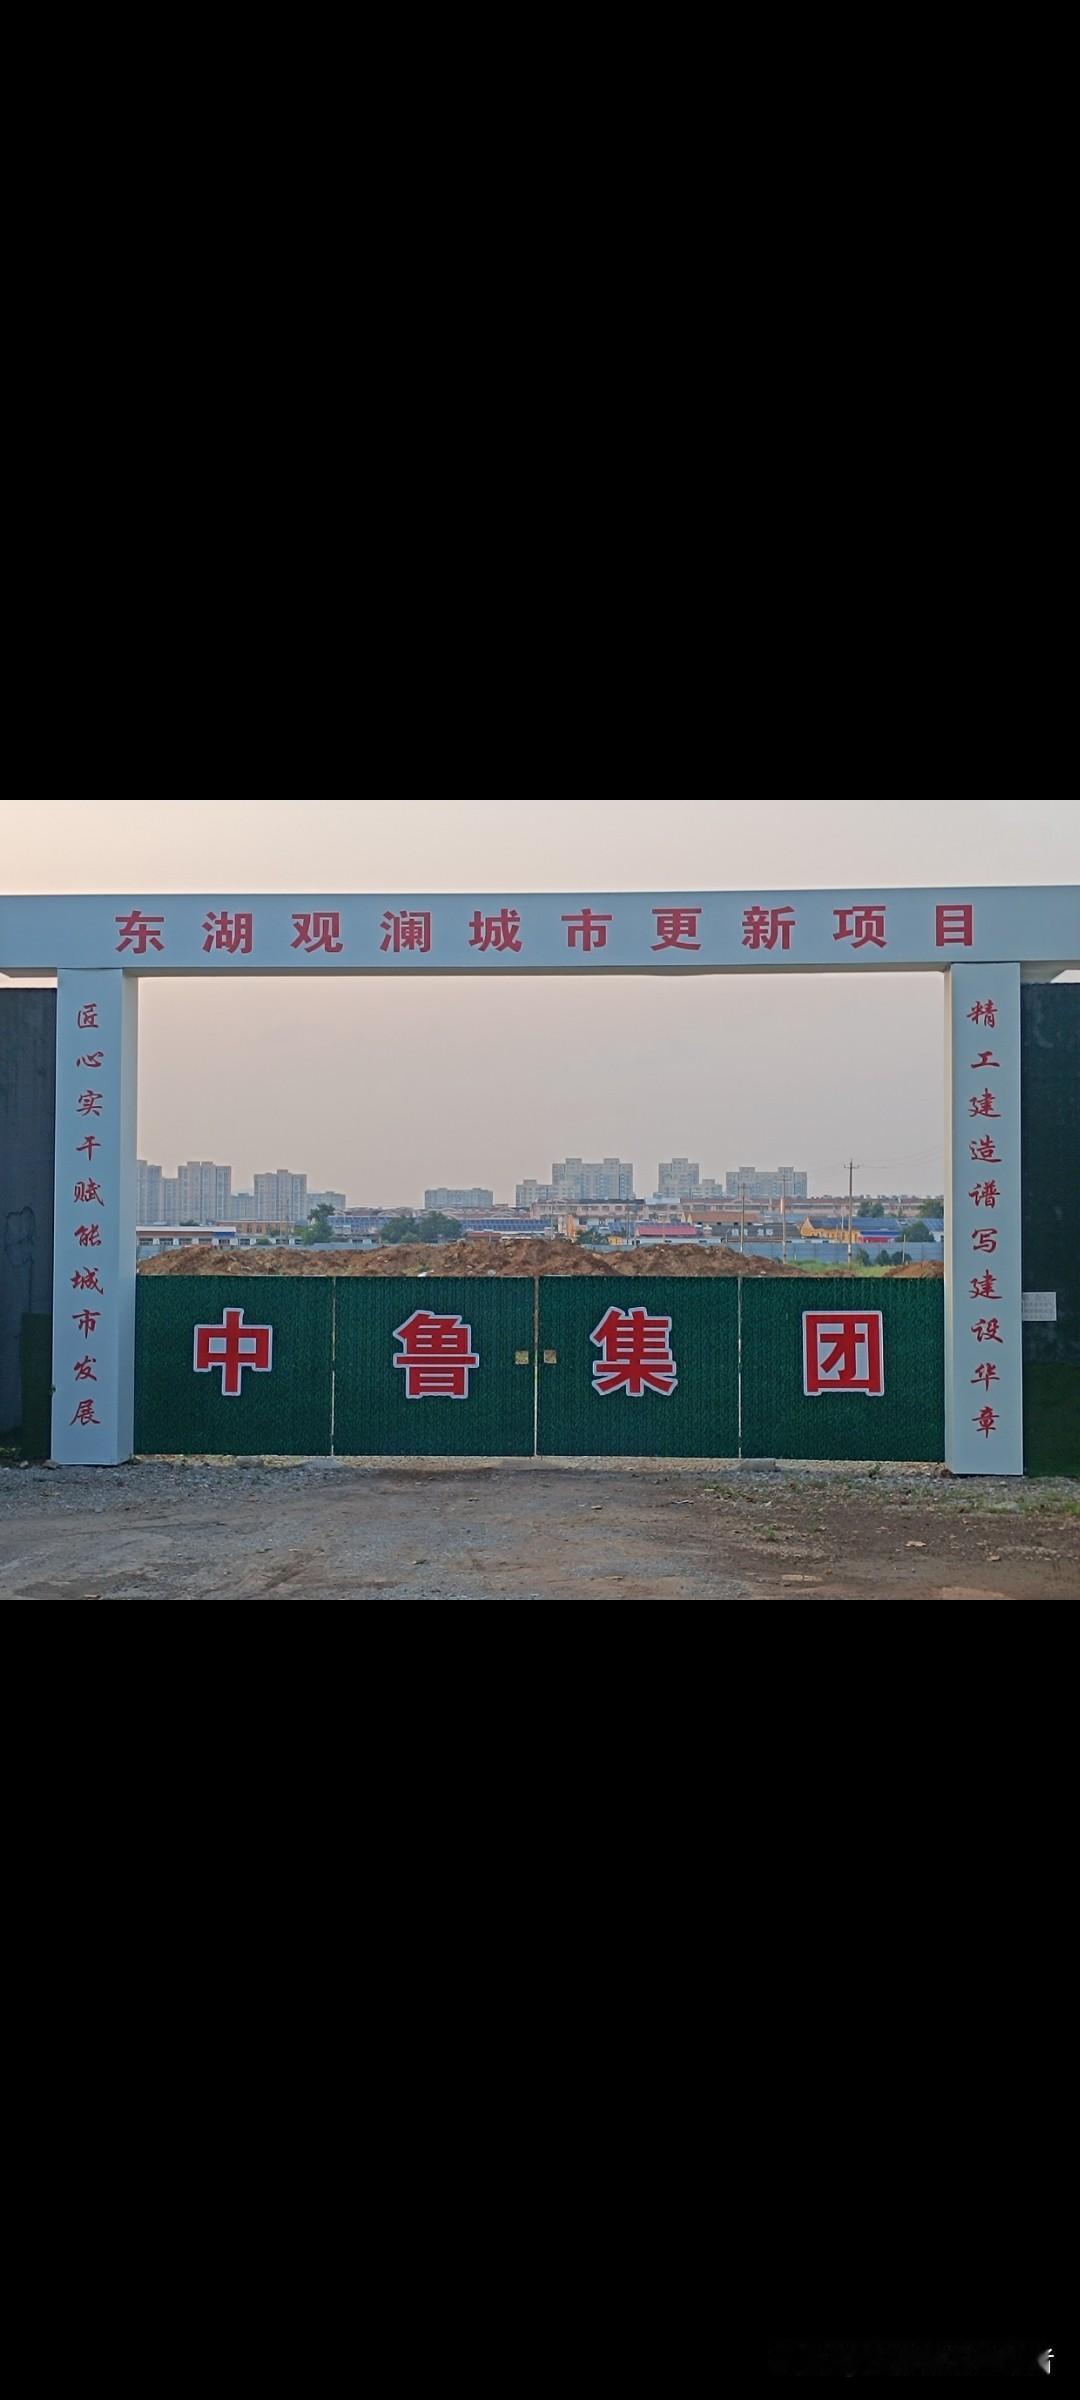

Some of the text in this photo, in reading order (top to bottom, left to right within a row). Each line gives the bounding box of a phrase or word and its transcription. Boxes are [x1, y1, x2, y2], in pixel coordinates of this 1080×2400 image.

[114, 903, 975, 954] 东湖观澜城市更新项目
[69, 1002, 104, 1427] 匠心实干赋能城市发展
[965, 999, 1004, 1439] 精工建造谱写建设华章
[193, 1306, 885, 1400] 中鲁集团
